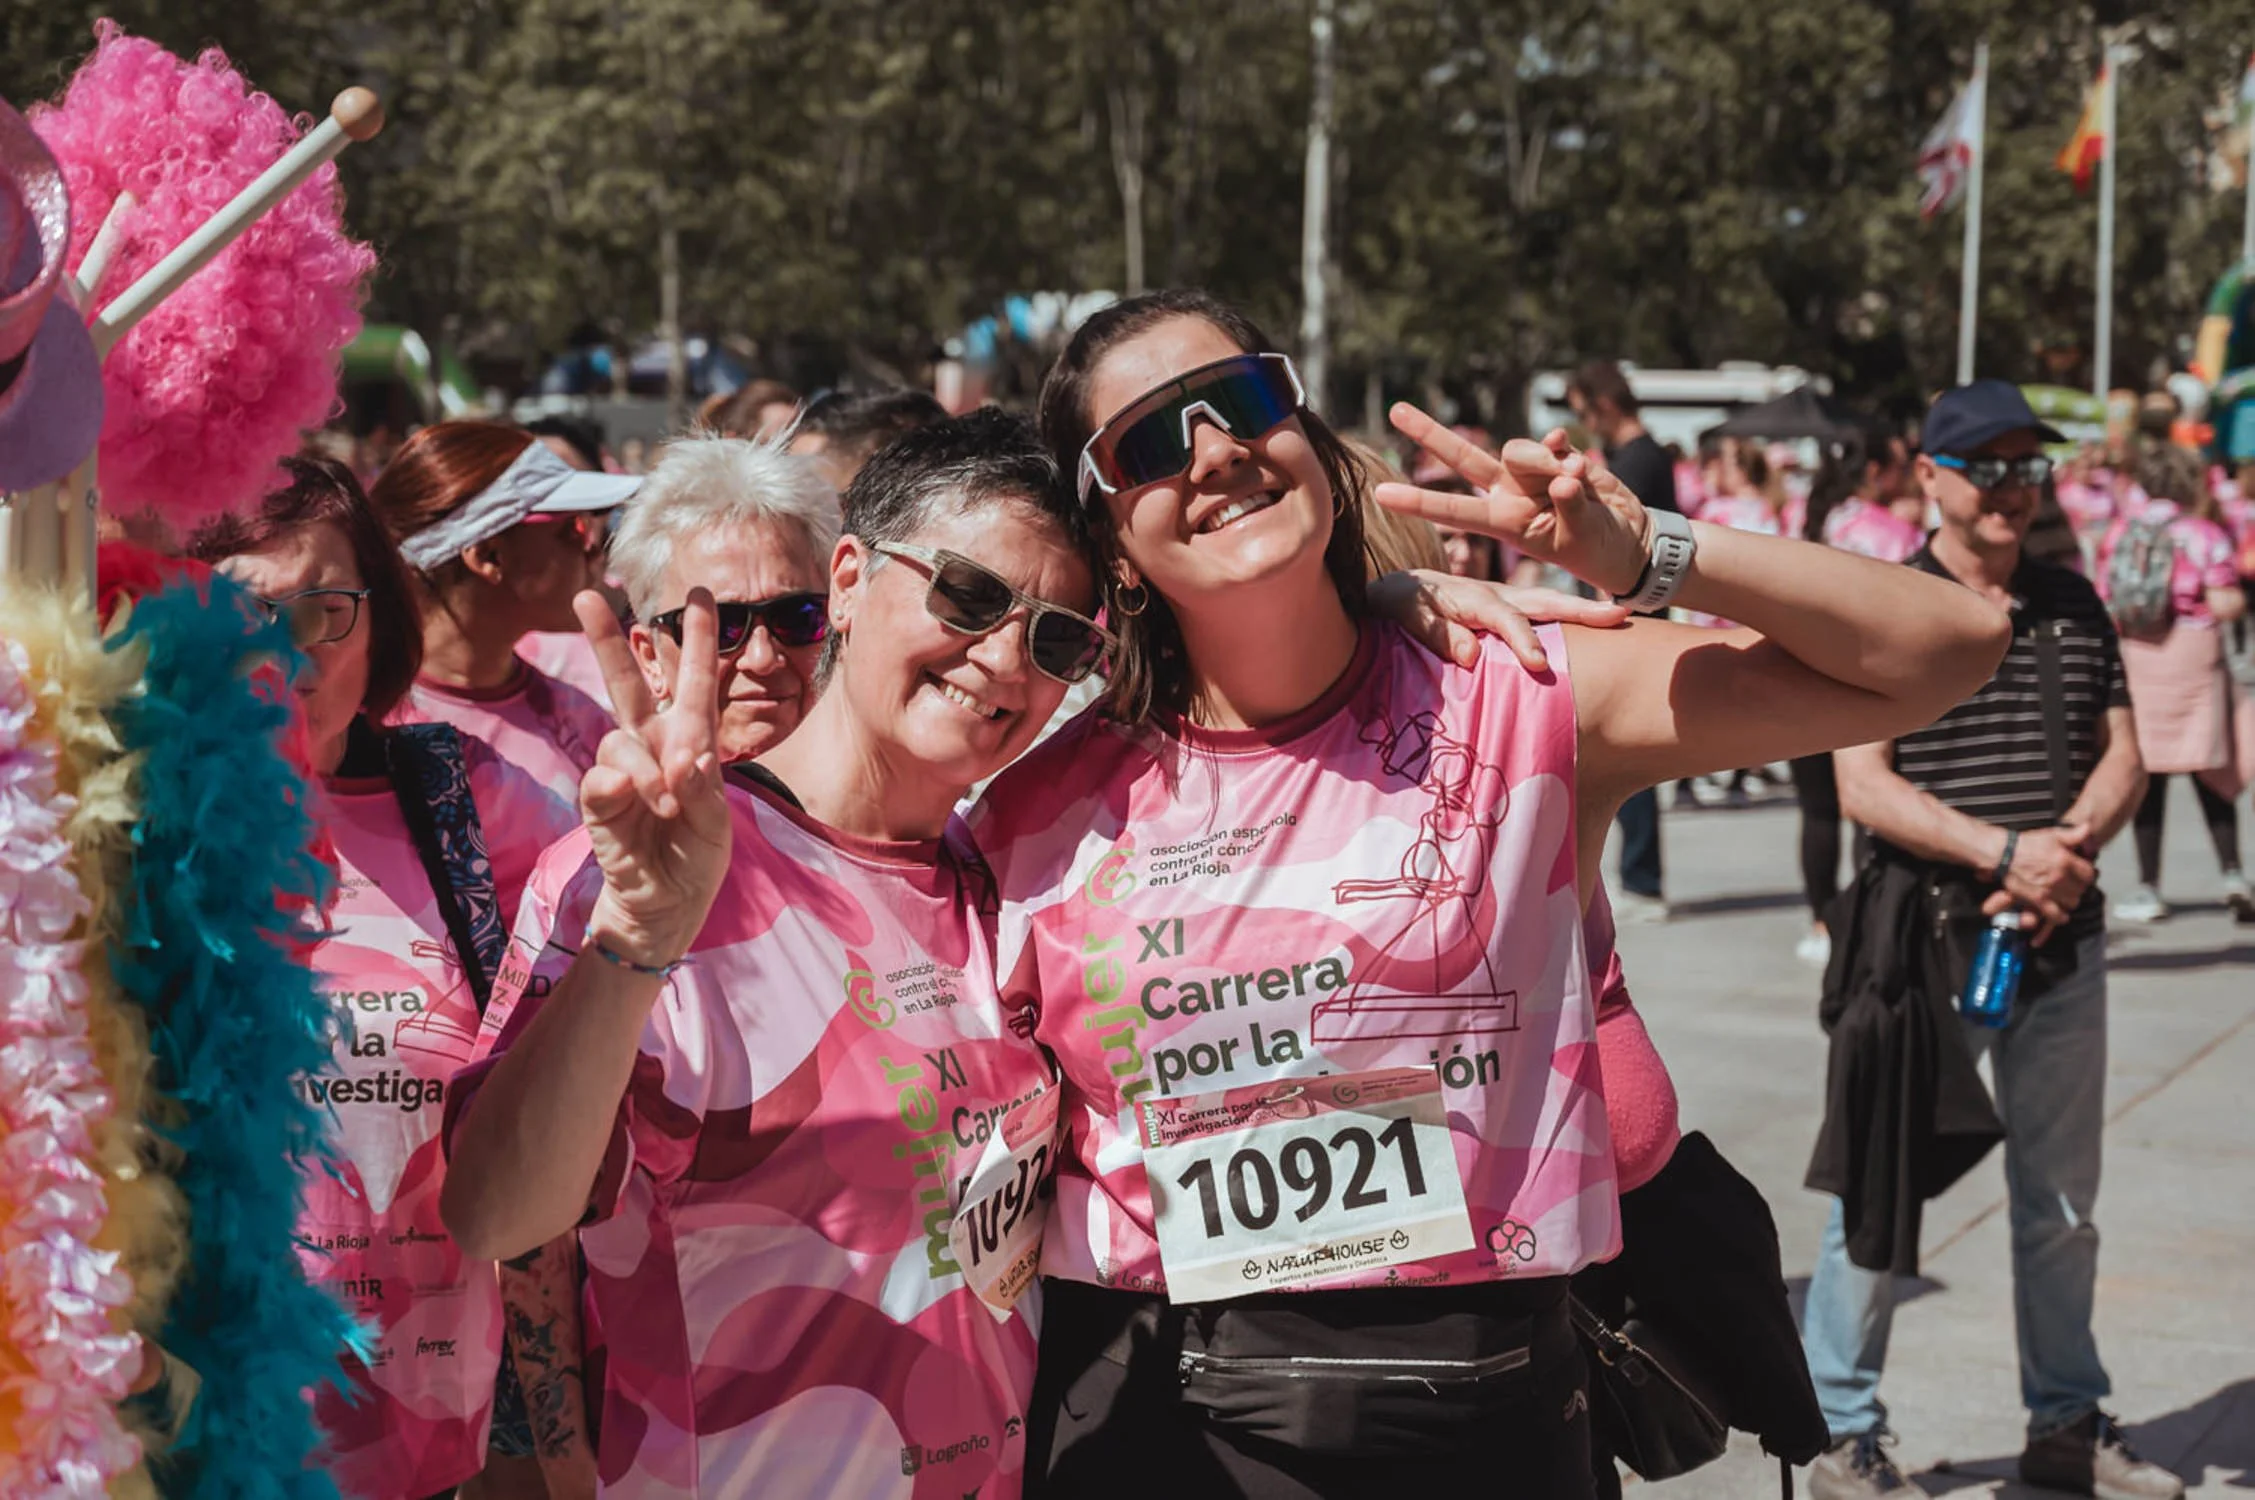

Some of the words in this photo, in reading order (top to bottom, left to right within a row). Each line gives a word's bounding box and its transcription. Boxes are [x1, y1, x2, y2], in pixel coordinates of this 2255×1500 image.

[1149, 875, 1169, 887] en
[1172, 870, 1189, 884] La
[1191, 860, 1231, 878] Rioja
[1150, 853, 1198, 873] contra
[1136, 917, 1185, 965] XI
[1140, 956, 1349, 1021] Carrera
[350, 1024, 387, 1058] la
[923, 1047, 969, 1092] XI
[1152, 1036, 1240, 1096] por
[1248, 1022, 1305, 1067] la
[1156, 1108, 1175, 1127] XI
[1178, 1105, 1229, 1125] Carrera
[1230, 1101, 1253, 1114] por
[877, 1055, 963, 1280] mujer
[1176, 1116, 1428, 1240] 10921
[317, 1235, 334, 1250] La
[336, 1233, 371, 1252] Rioja
[415, 1335, 458, 1358] ferrer
[926, 1433, 990, 1466] Logroño
